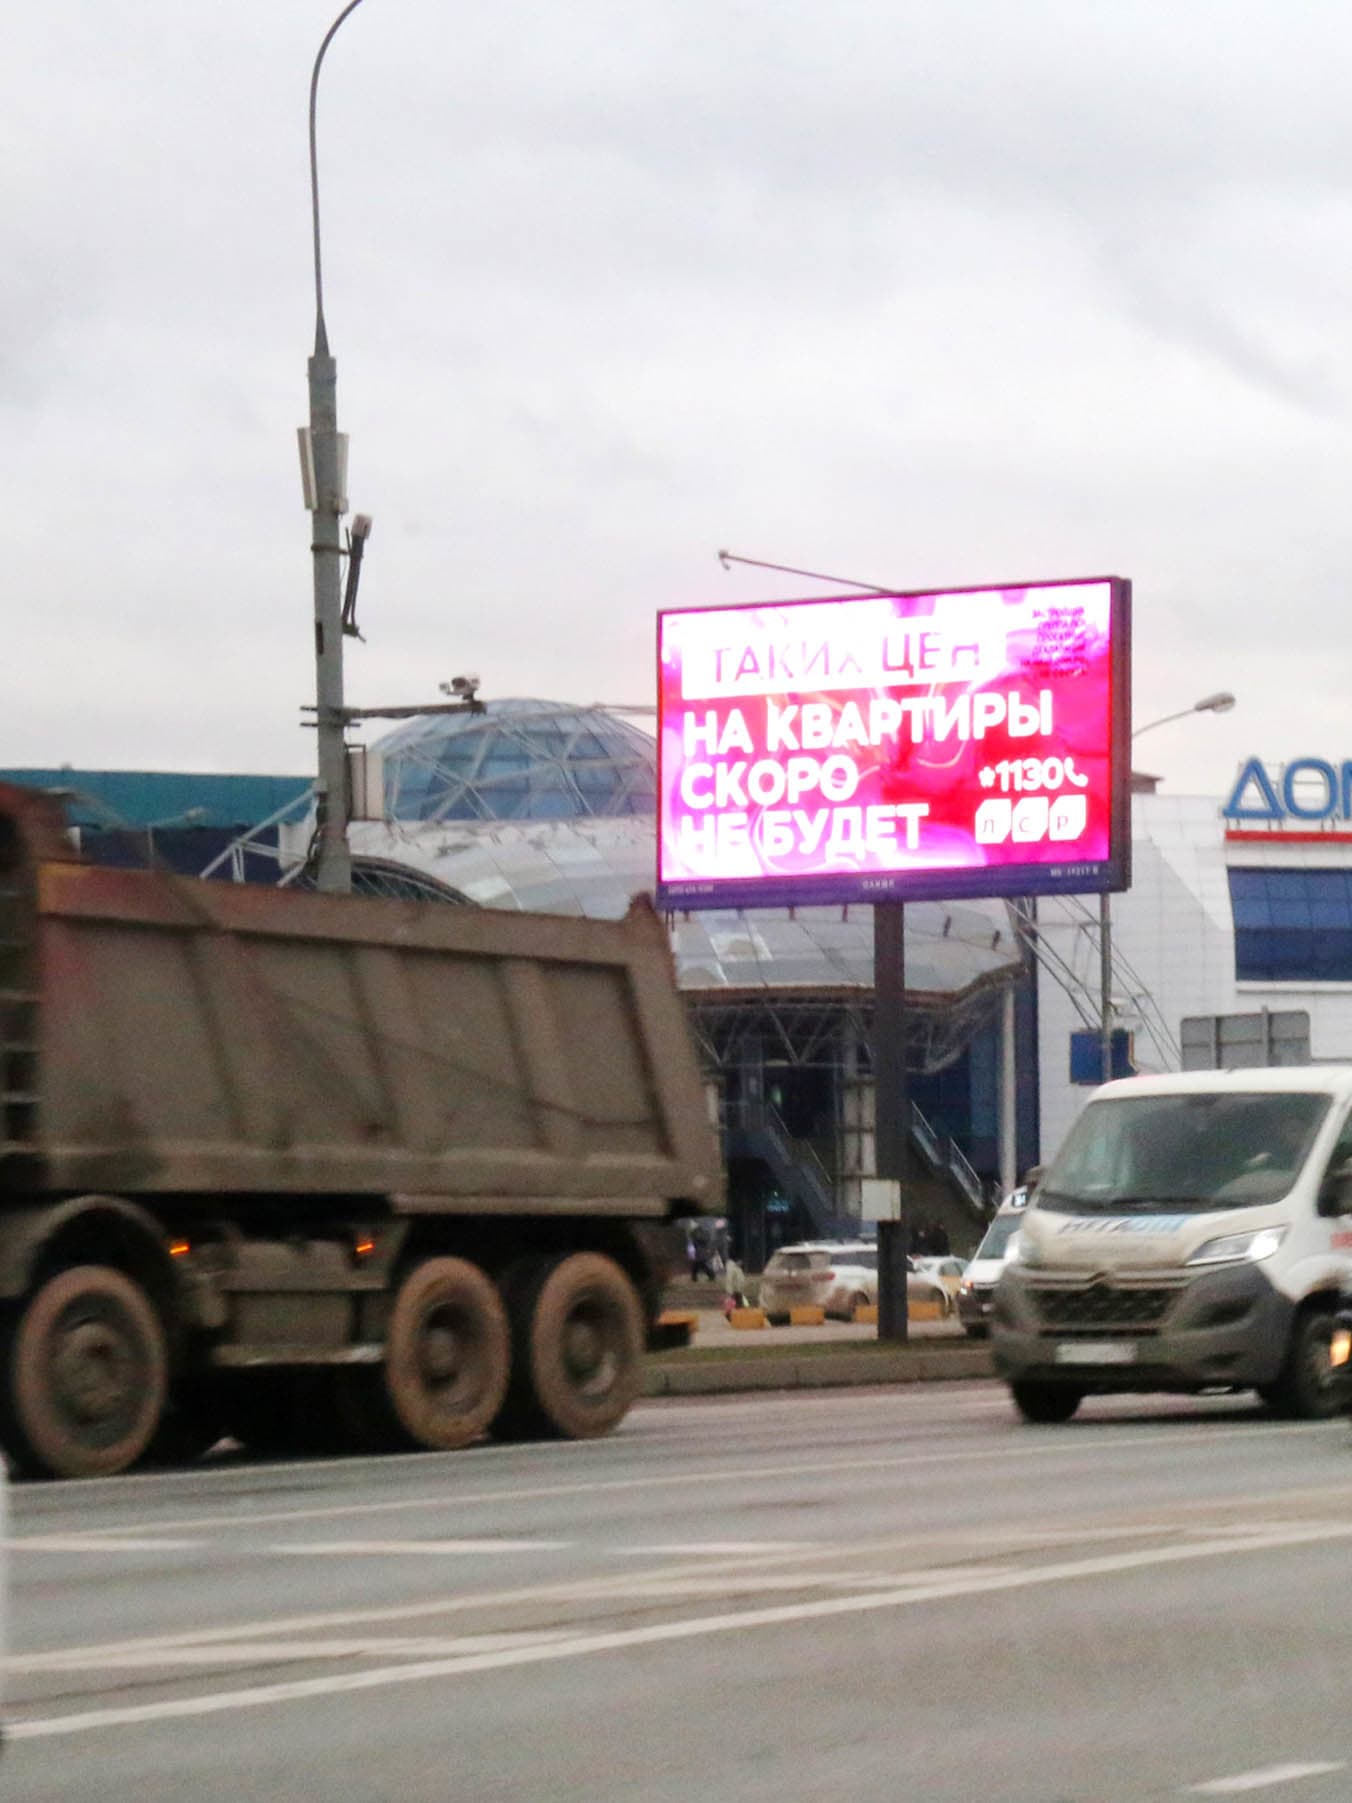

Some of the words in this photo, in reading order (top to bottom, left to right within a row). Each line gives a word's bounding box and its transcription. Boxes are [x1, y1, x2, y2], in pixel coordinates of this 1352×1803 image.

[683, 708, 754, 756] НА
[766, 689, 1053, 752] КВАРТИРЫ
[681, 754, 858, 809] СКОРО
[680, 811, 750, 860] НЕ
[763, 803, 930, 863] БУДЕТ
